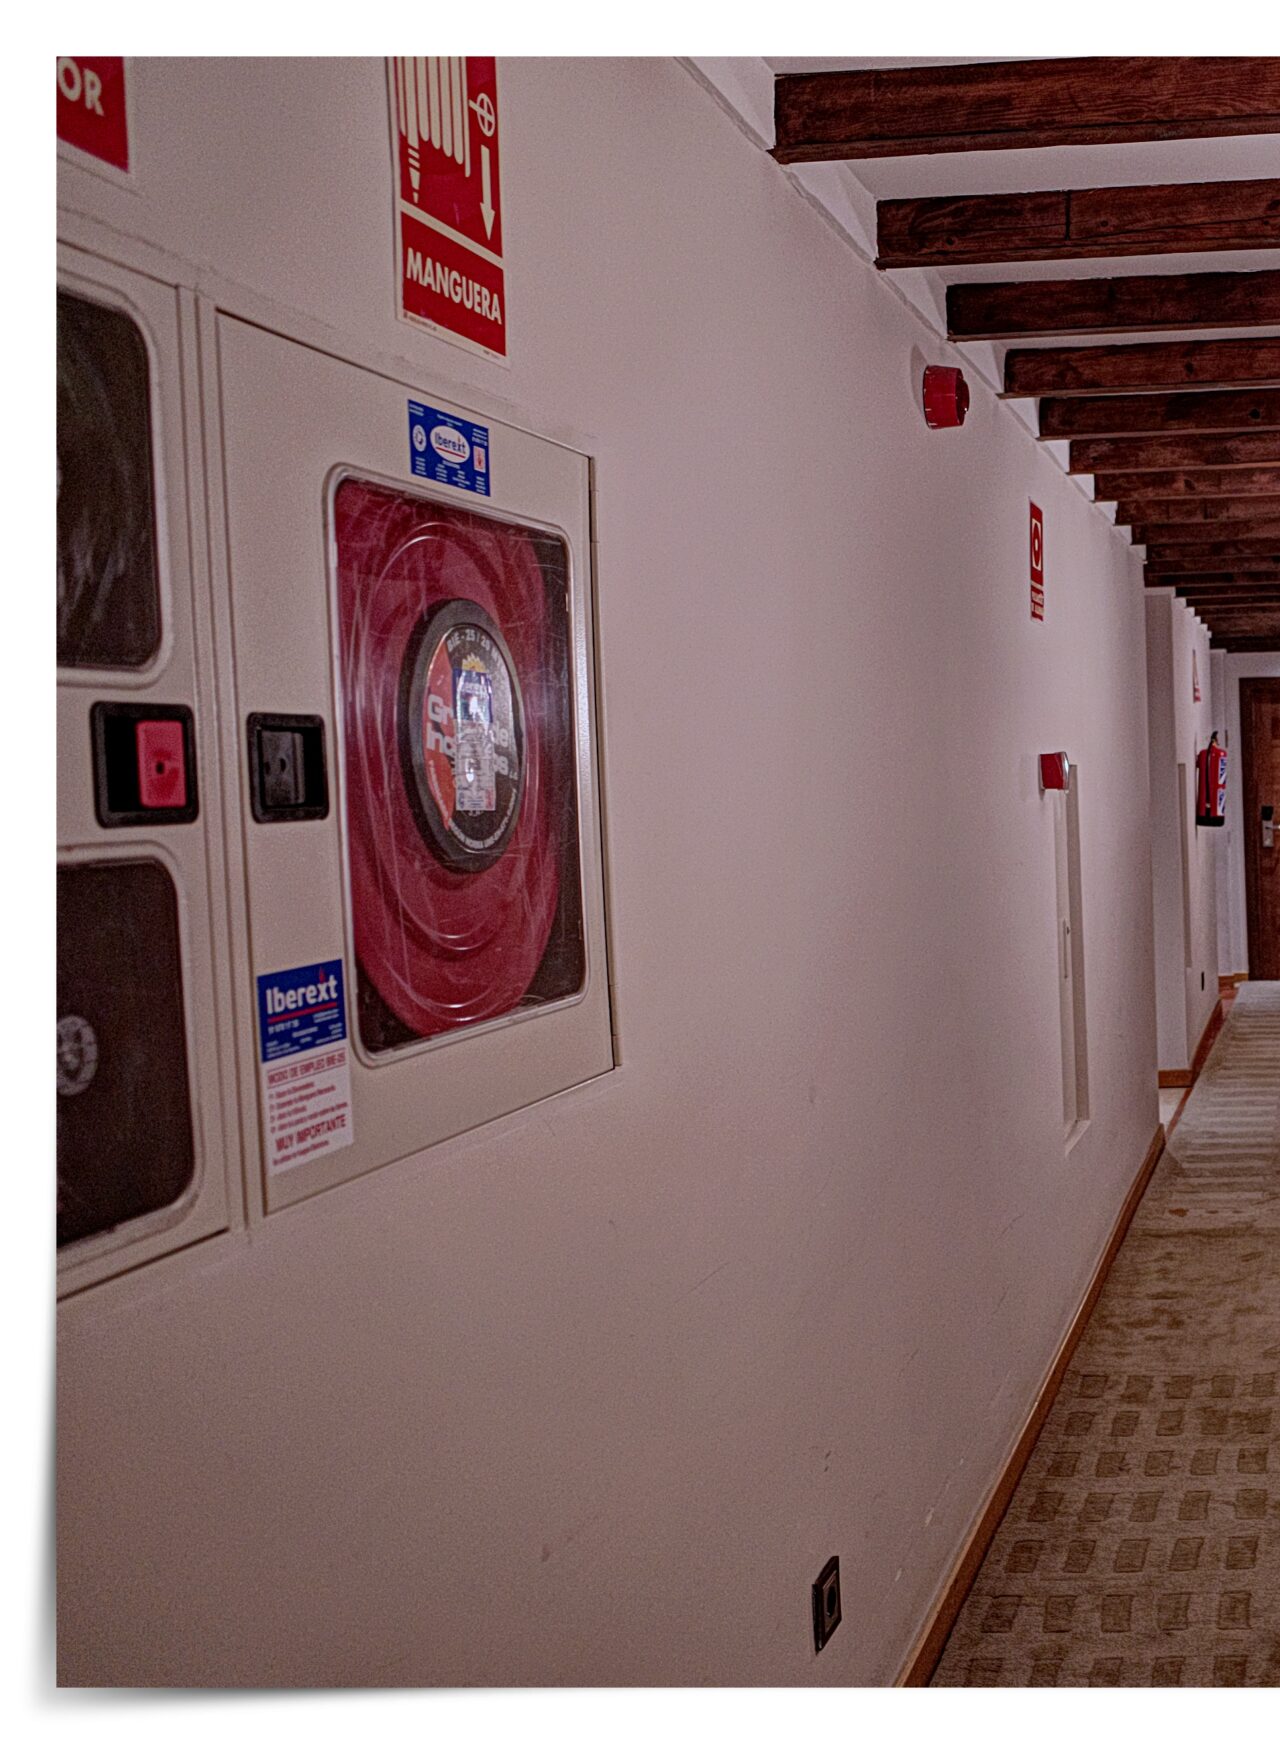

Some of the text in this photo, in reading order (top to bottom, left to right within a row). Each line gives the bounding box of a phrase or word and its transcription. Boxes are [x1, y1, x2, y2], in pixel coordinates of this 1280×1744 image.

[406, 247, 502, 325] MANGUERA
[434, 431, 466, 455] Iberext
[265, 974, 338, 1015] Iberext
[275, 1134, 294, 1152] MUY
[296, 1113, 346, 1144] IMPORTANTE
